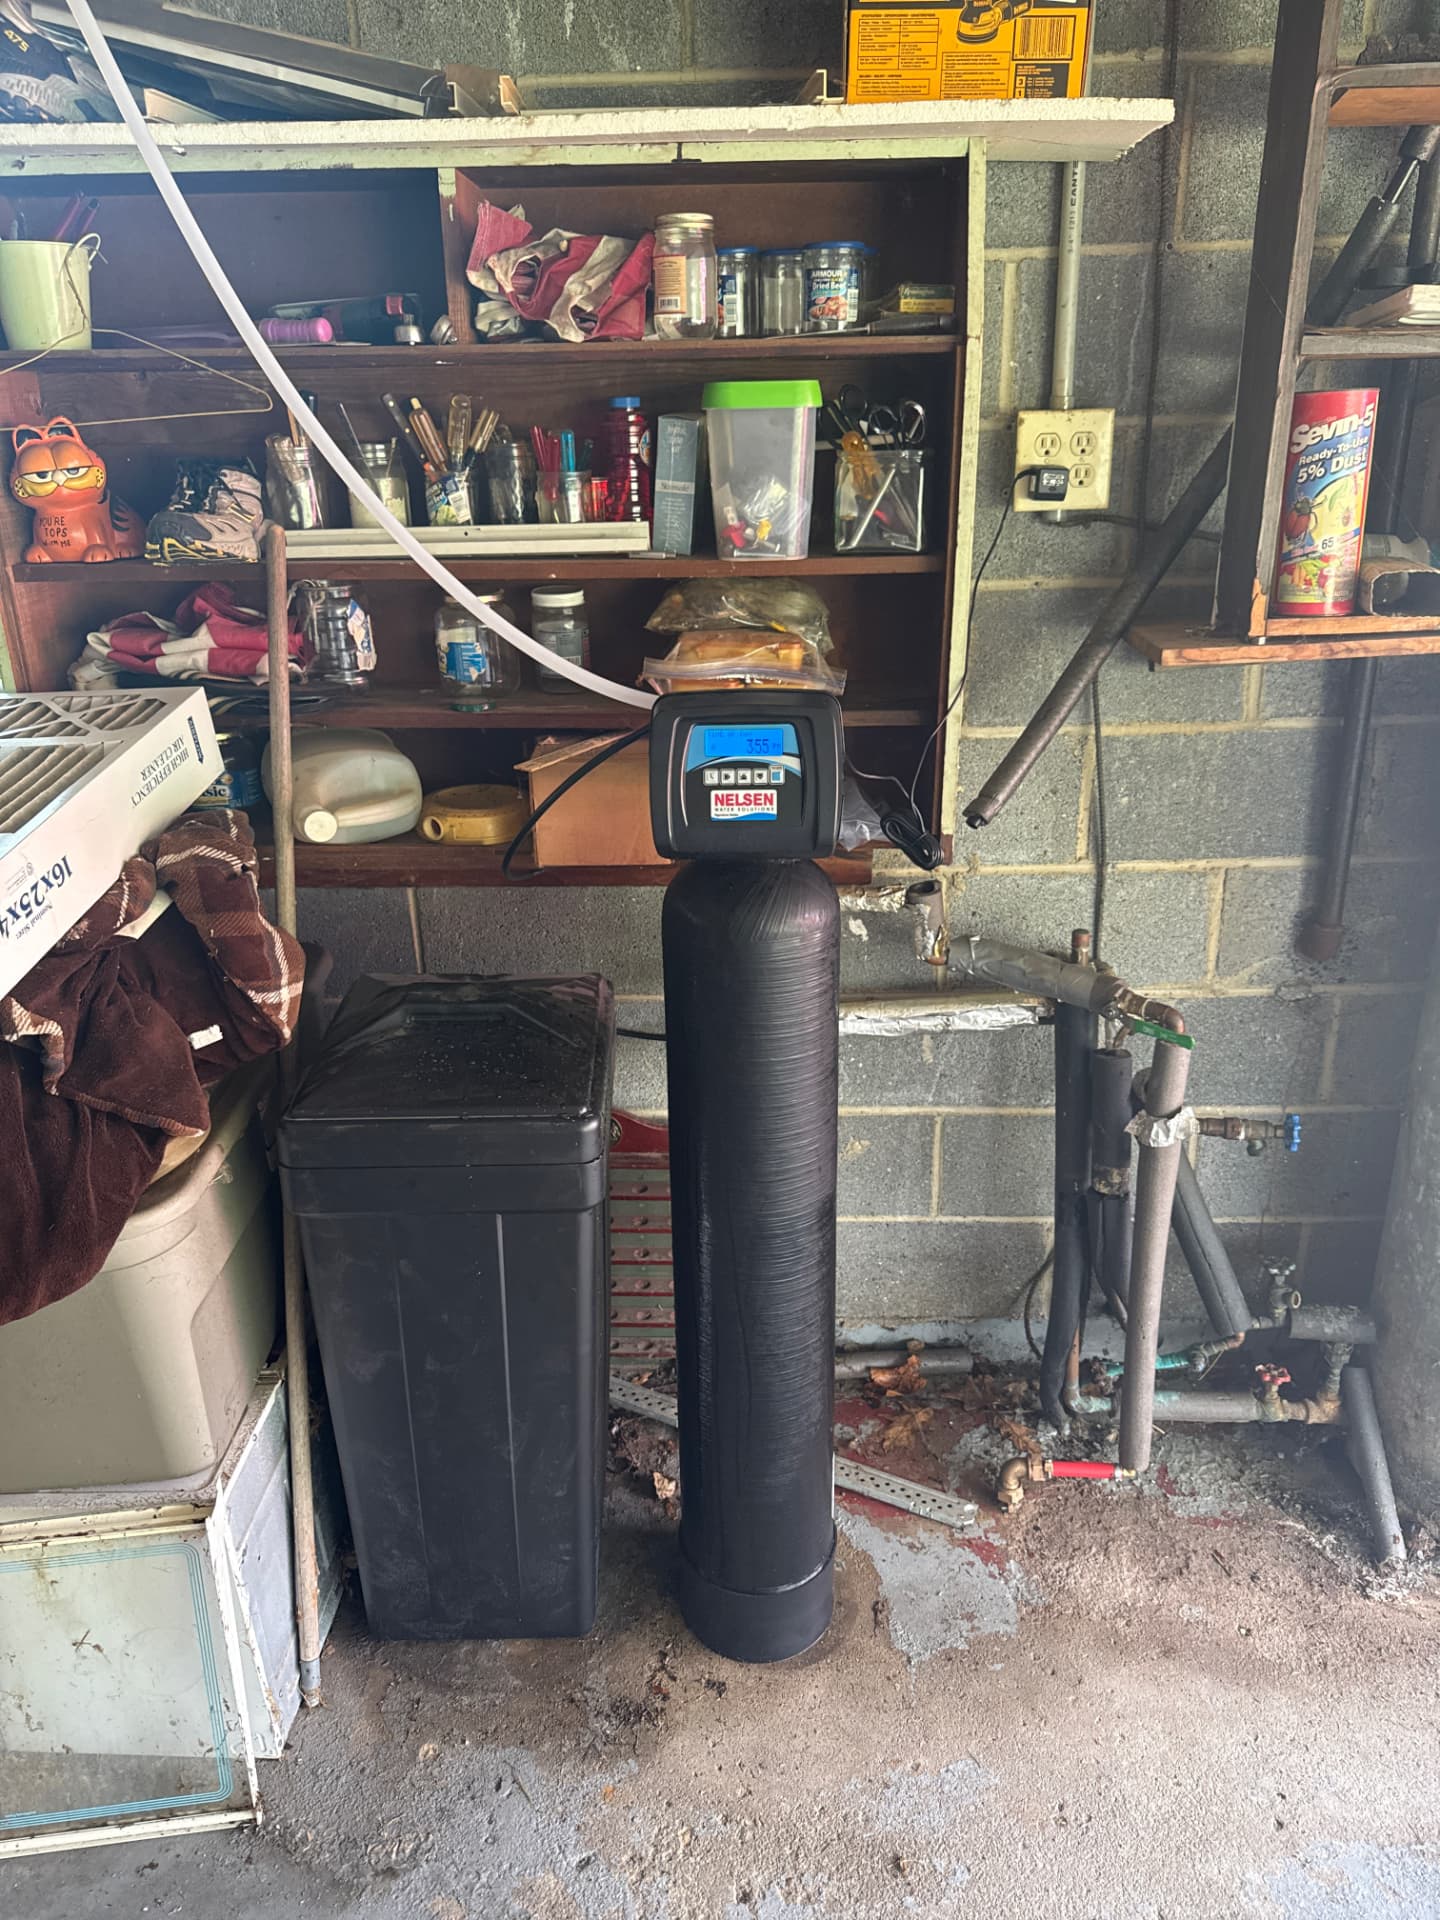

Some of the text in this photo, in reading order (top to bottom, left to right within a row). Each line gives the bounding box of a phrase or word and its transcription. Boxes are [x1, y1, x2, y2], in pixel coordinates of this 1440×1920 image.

[4, 29, 30, 53] 475
[811, 269, 843, 279] ARMOUR
[813, 280, 830, 291] Dried
[1290, 402, 1375, 455] Sevin-5
[1299, 436, 1369, 466] Ready-To-Use
[1297, 447, 1367, 483] 5% Dust
[44, 527, 68, 538] TOPS
[1321, 537, 1335, 550] 65
[172, 735, 185, 753] AIR
[140, 746, 173, 781] CLEANER
[130, 746, 190, 808] HIGH EFFICIENCY
[714, 793, 775, 807] NELSEN
